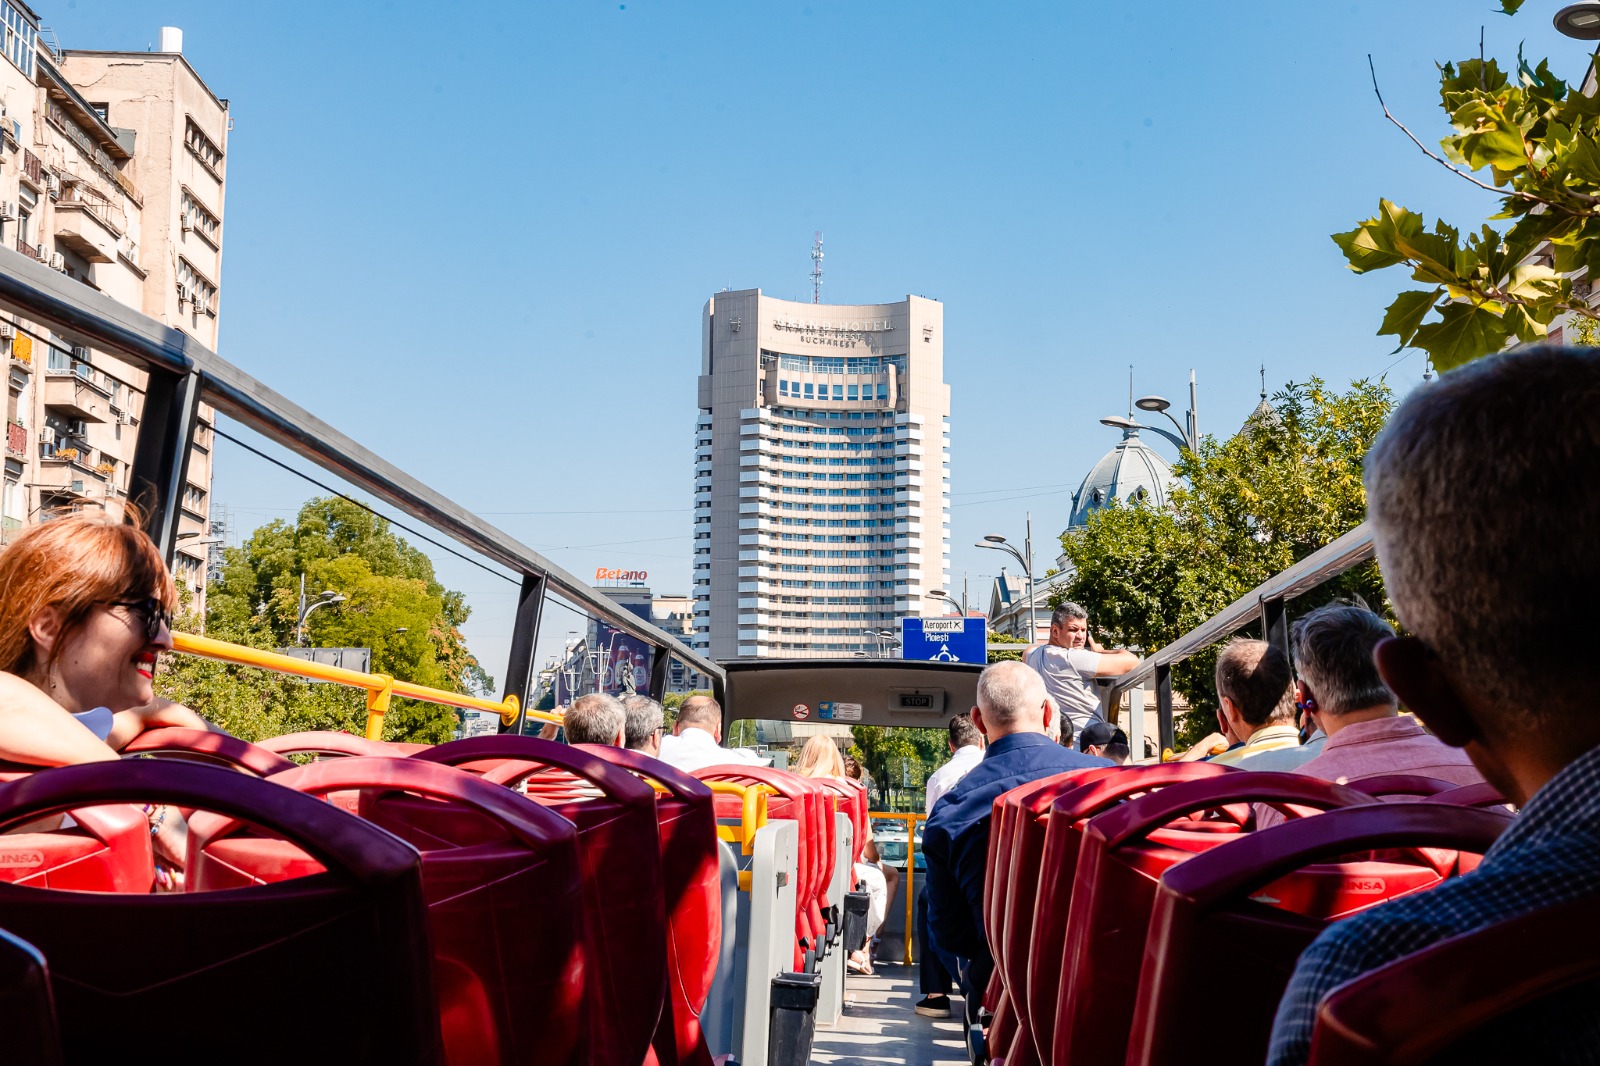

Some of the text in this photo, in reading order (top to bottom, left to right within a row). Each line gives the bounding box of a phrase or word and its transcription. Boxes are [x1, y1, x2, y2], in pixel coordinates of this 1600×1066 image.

[775, 317, 891, 332] GRAND HOTEL
[800, 334, 859, 349] BUCHAREST
[596, 567, 648, 580] Betano
[924, 620, 953, 630] Aeroport
[905, 698, 927, 706] STOP
[0, 854, 41, 863] INSA
